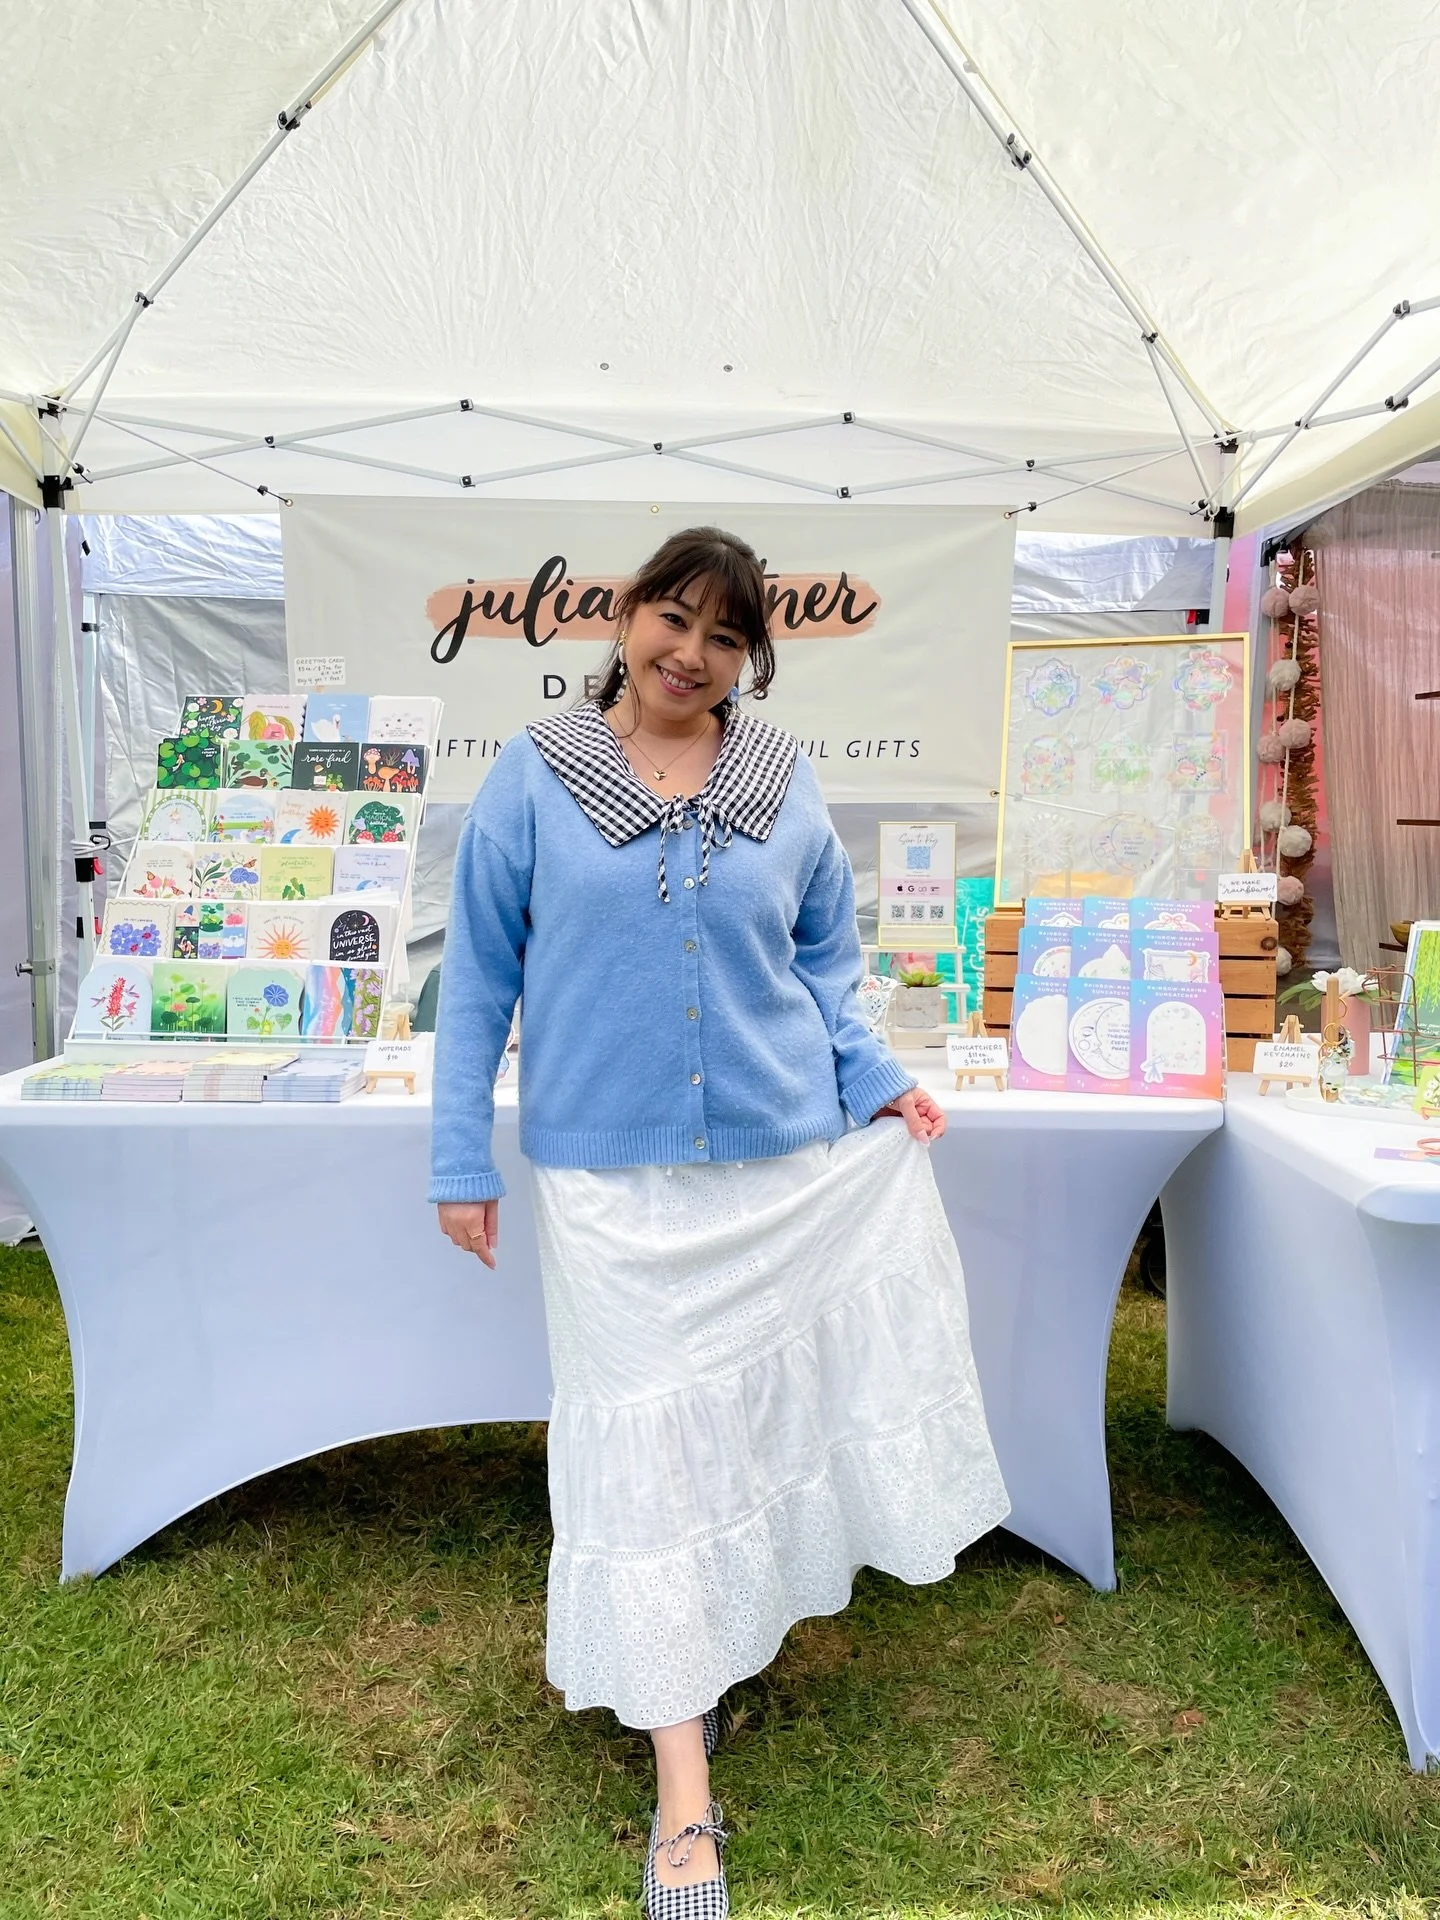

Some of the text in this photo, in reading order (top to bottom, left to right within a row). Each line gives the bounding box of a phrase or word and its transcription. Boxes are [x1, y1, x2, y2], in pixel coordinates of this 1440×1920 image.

[430, 555, 614, 664] julia
[846, 740, 920, 758] GIFTS
[301, 750, 352, 768] rare find
[969, 907, 989, 1012] omeGoods
[951, 1044, 1003, 1052] SUNCATCHERS
[1263, 1051, 1311, 1060] KEYCHAINS
[1273, 1045, 1306, 1053] ENAMEL
